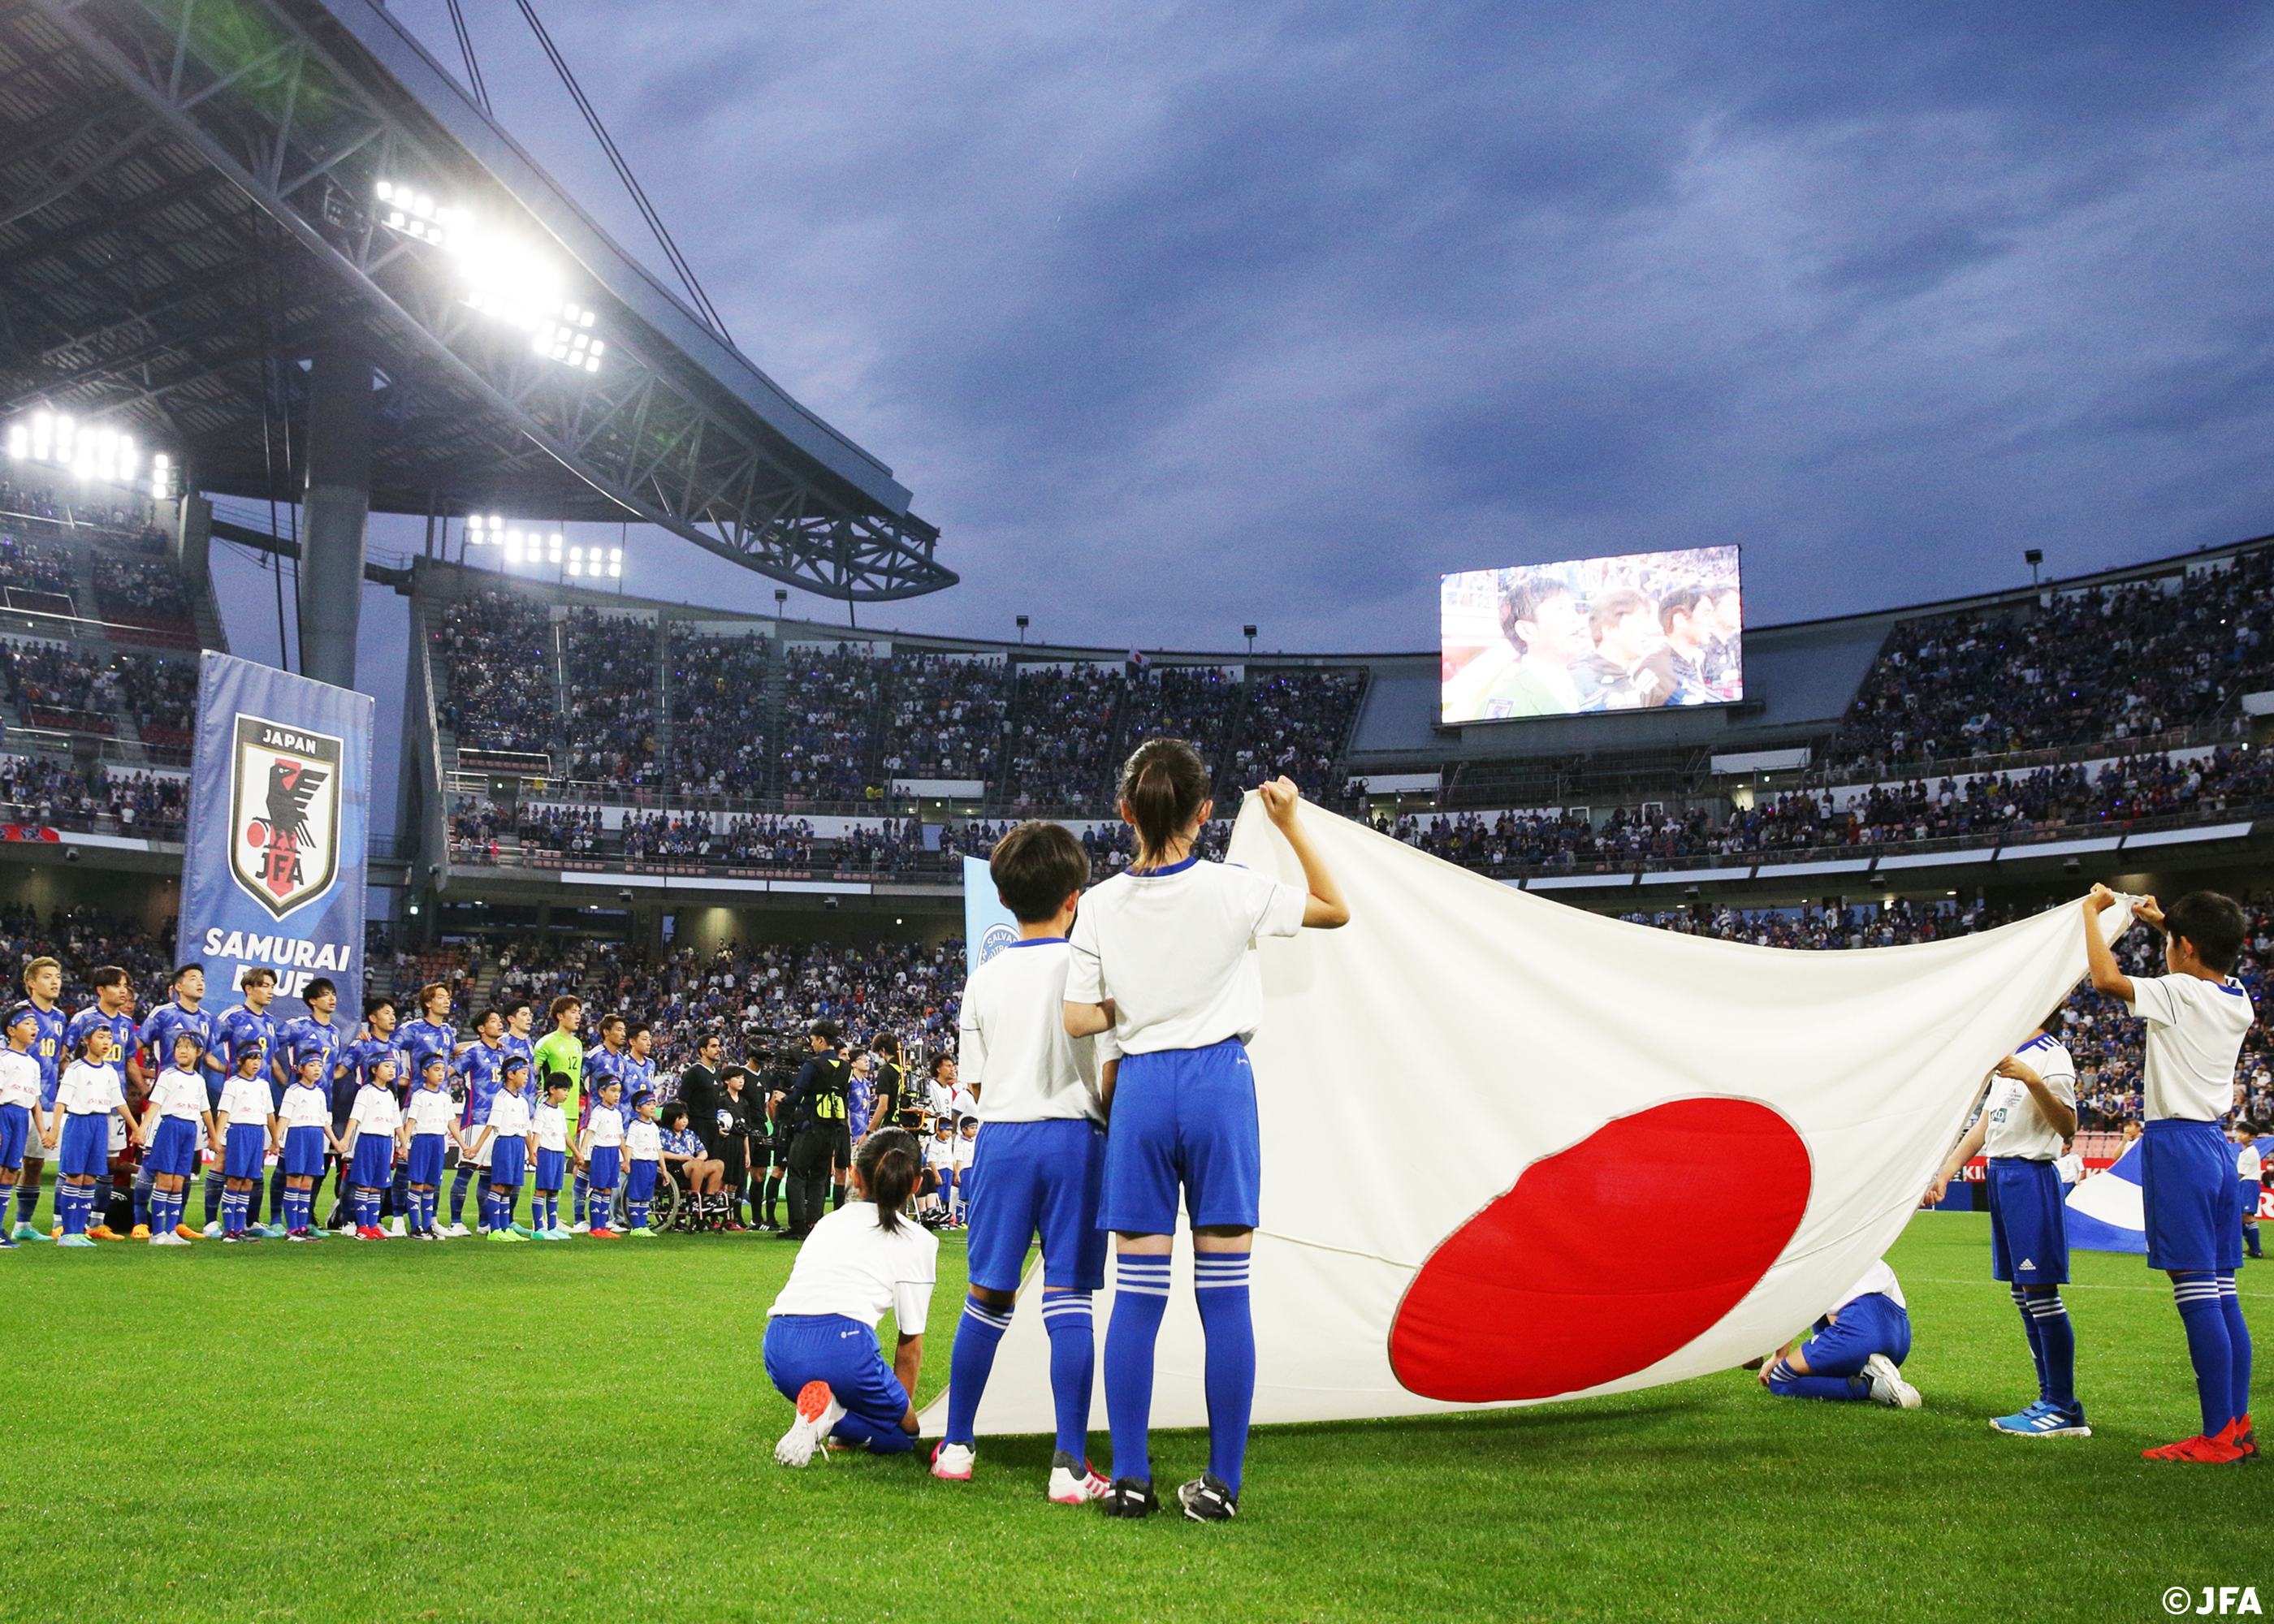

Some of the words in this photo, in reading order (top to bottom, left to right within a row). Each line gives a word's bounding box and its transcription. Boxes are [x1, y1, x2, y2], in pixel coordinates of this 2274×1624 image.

[262, 729, 317, 754] JAPAN
[254, 853, 305, 886] JFA
[202, 927, 351, 973] SAMURAI
[231, 964, 314, 999] BUE
[39, 1038, 56, 1057] 10
[102, 1043, 122, 1062] 20
[321, 1046, 331, 1064] 7
[568, 1056, 577, 1070] 12
